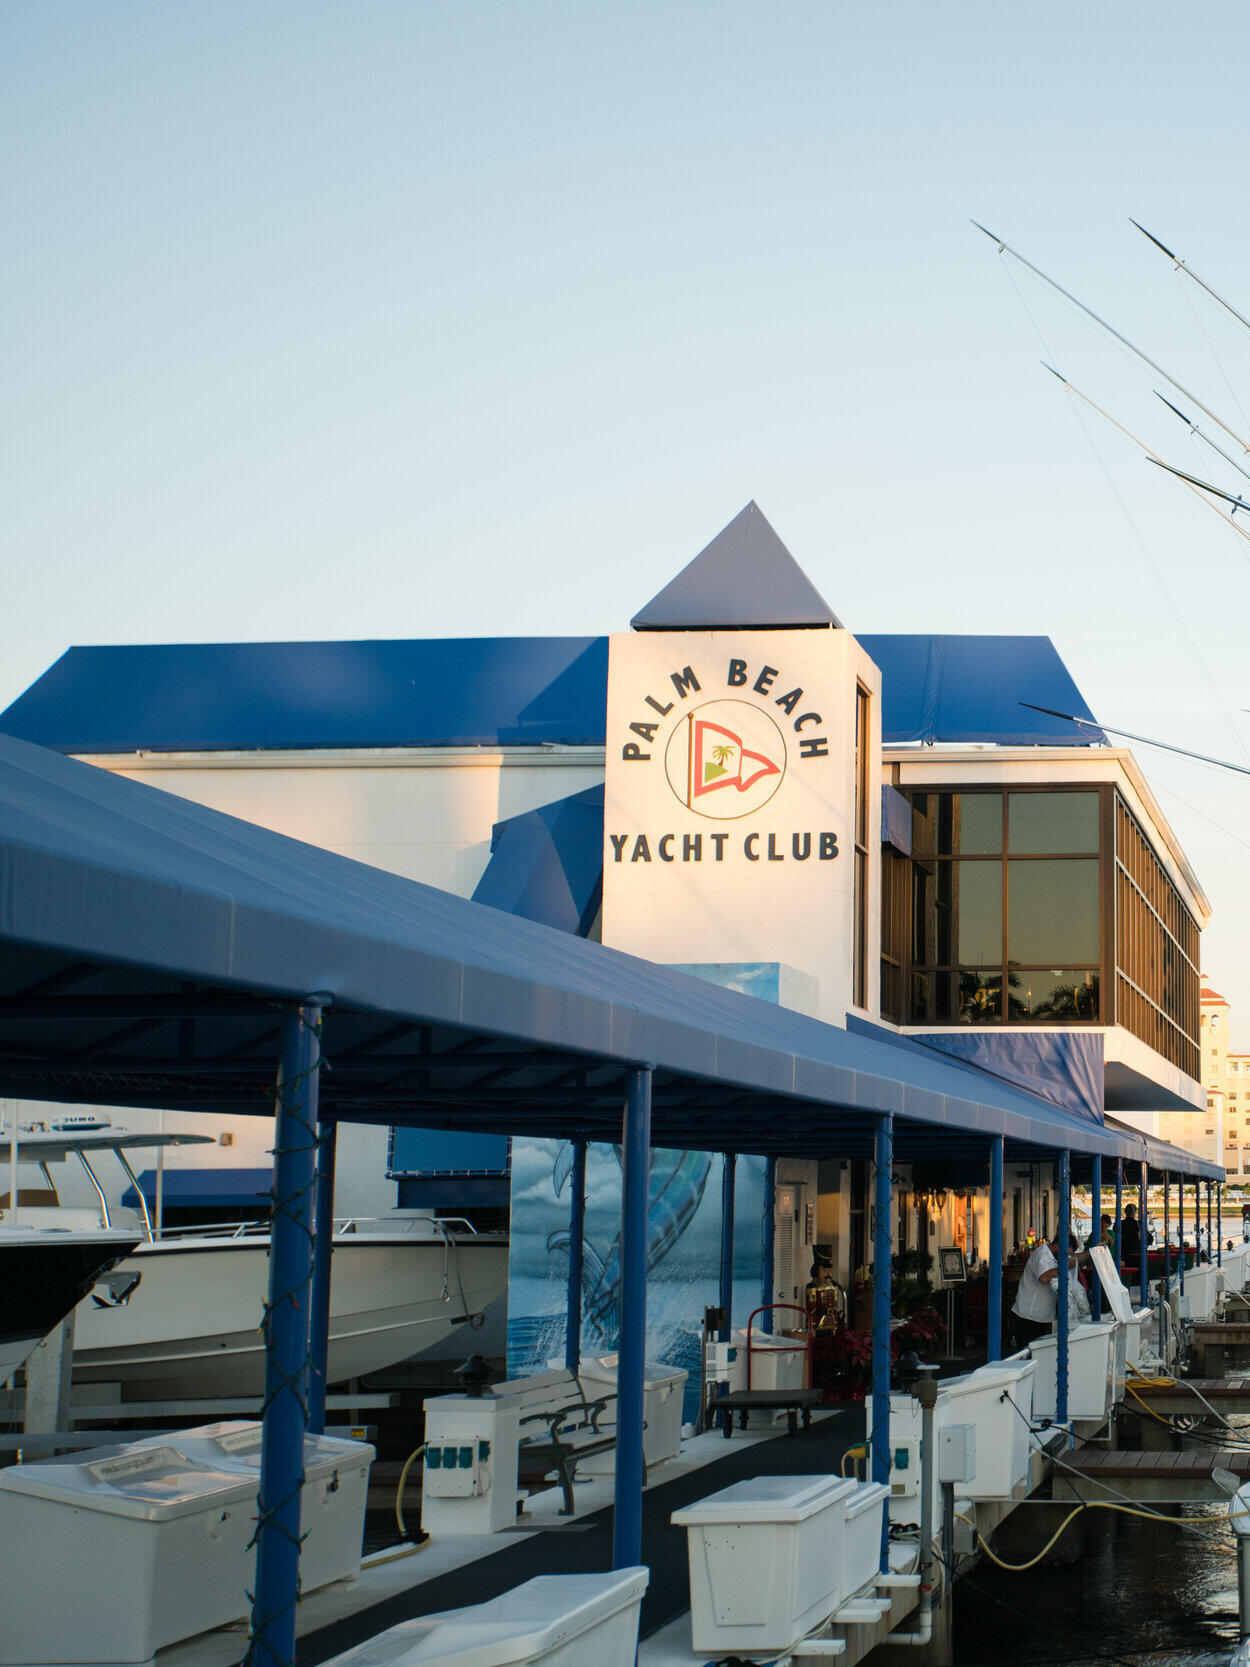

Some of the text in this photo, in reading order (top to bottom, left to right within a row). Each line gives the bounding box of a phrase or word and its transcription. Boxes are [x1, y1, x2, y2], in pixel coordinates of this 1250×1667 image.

[622, 658, 829, 761] PALM BEACH
[610, 832, 839, 863] YACHT CLUB
